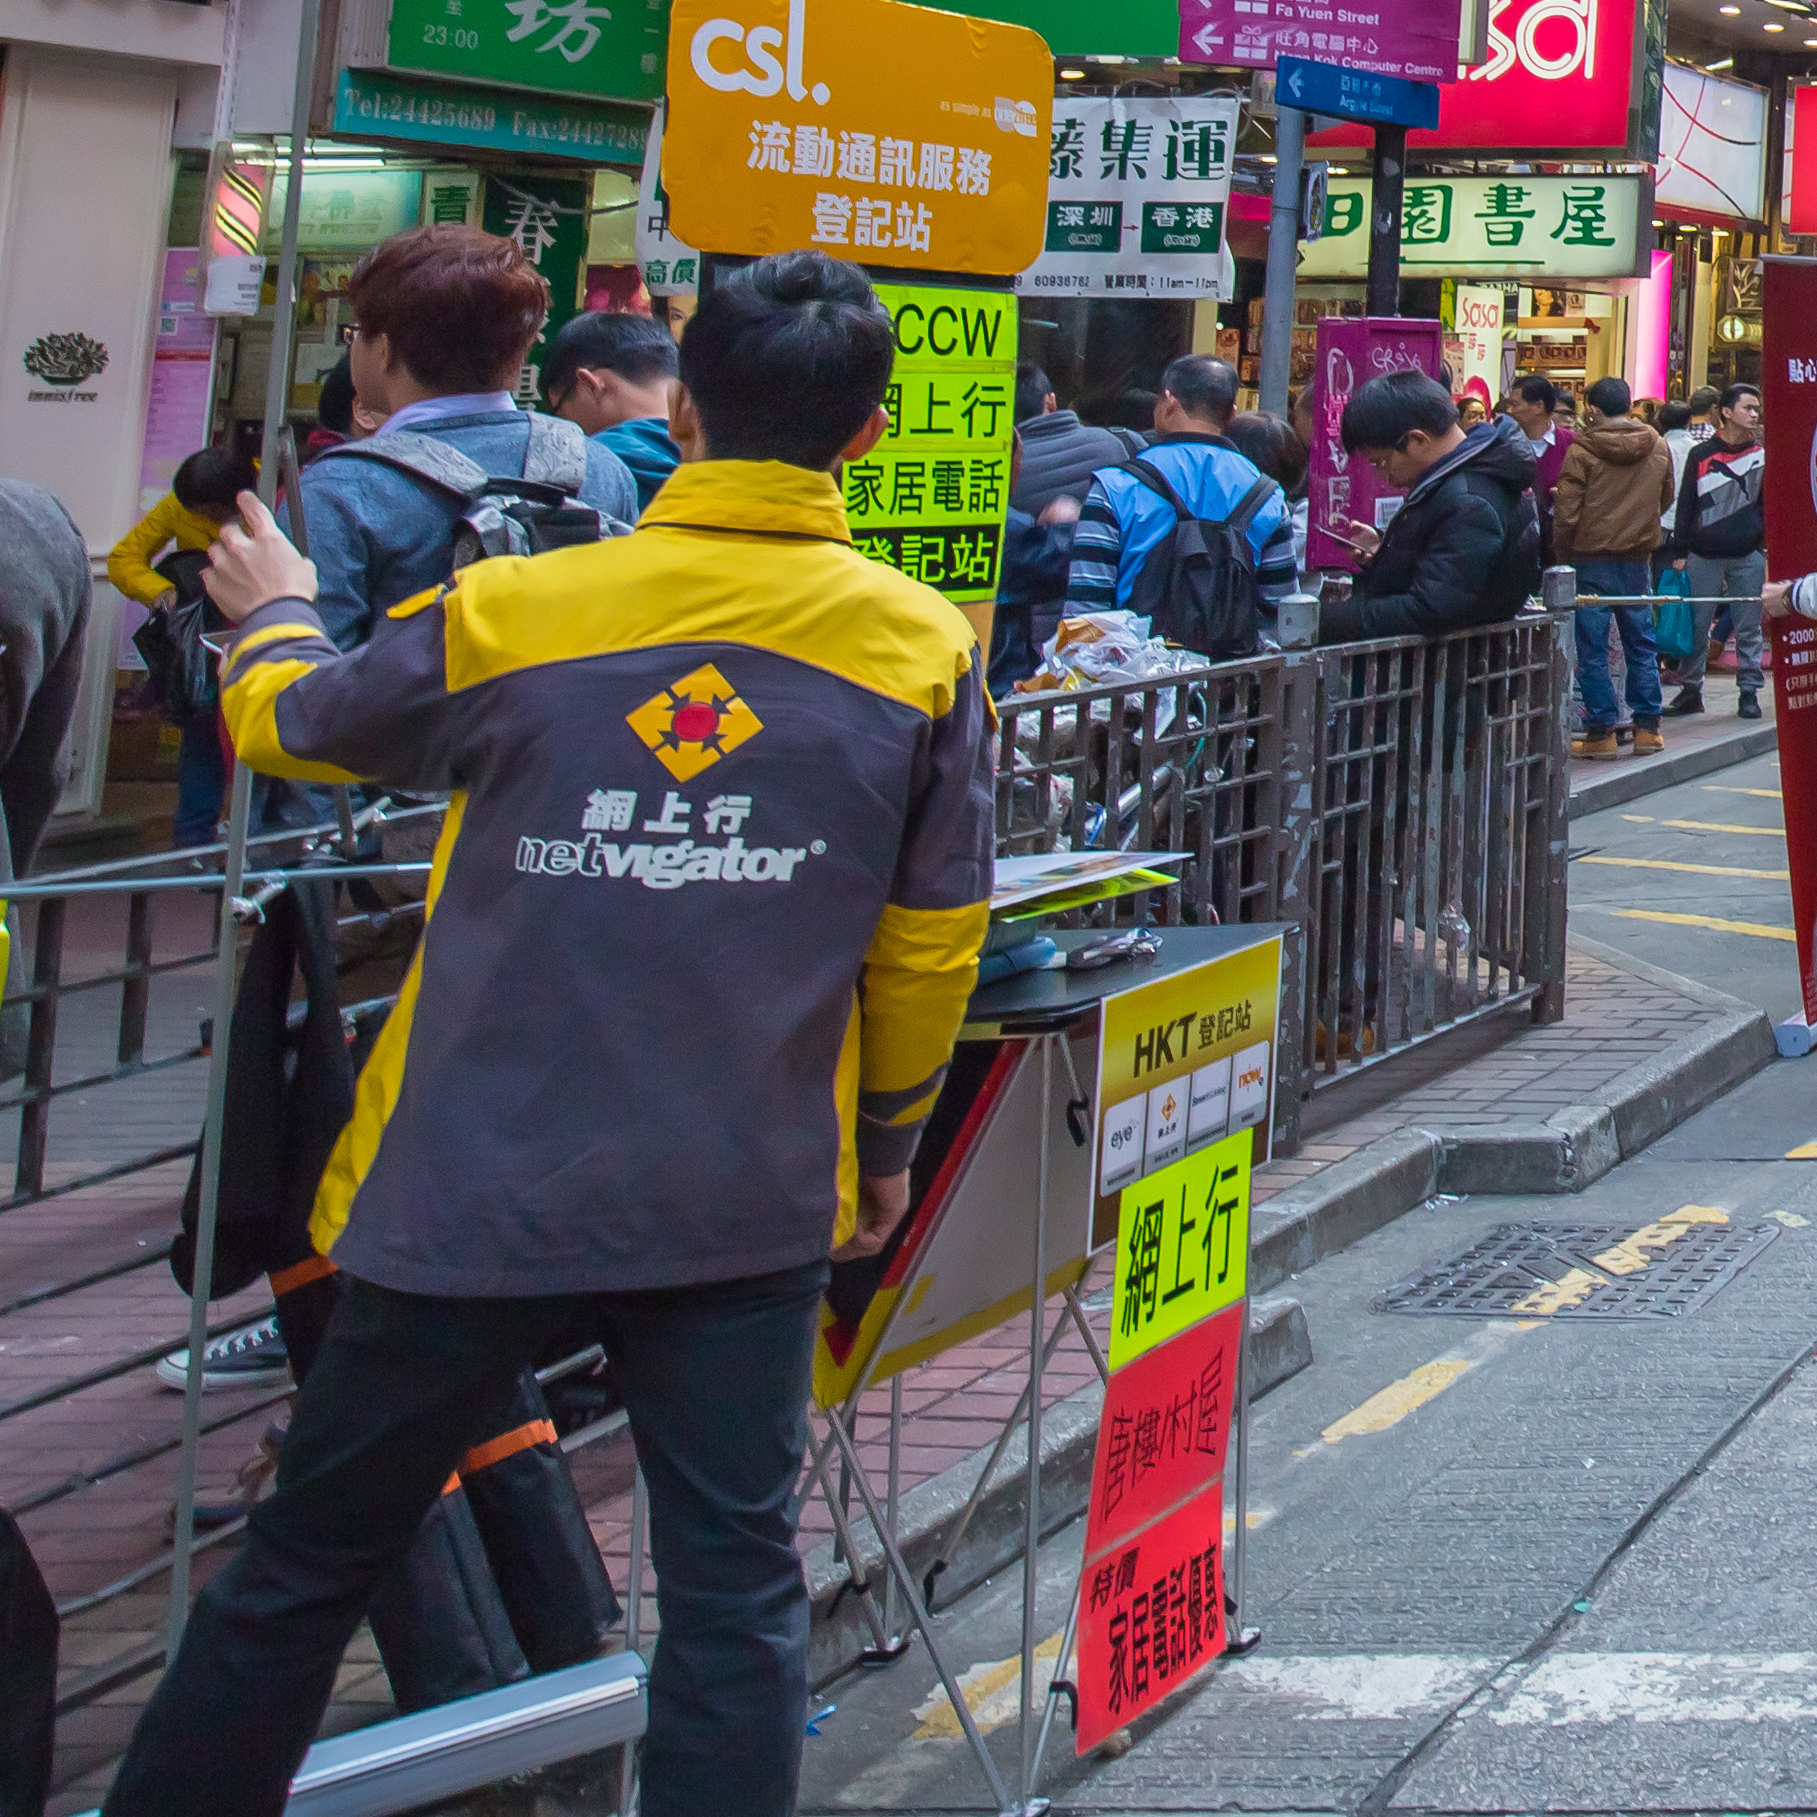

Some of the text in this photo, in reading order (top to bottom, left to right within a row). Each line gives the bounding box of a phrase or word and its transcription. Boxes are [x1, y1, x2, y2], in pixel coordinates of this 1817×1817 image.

[1275, 3, 1380, 27] Fa Yuen Street
[422, 23, 479, 51] 23:00
[1341, 56, 1444, 78] Computer Centre
[746, 119, 993, 196] 流動通訊服務
[810, 191, 934, 252] 登記站
[1056, 205, 1214, 229] 深圳 香港
[645, 258, 698, 285] 高價
[27, 387, 100, 405] innisfree
[847, 458, 1005, 515] 家居電話
[581, 789, 753, 836] 網上行
[1133, 999, 1252, 1079] HKT 登記站
[1110, 1125, 1134, 1151] eye
[1120, 1163, 1241, 1336] 網上行
